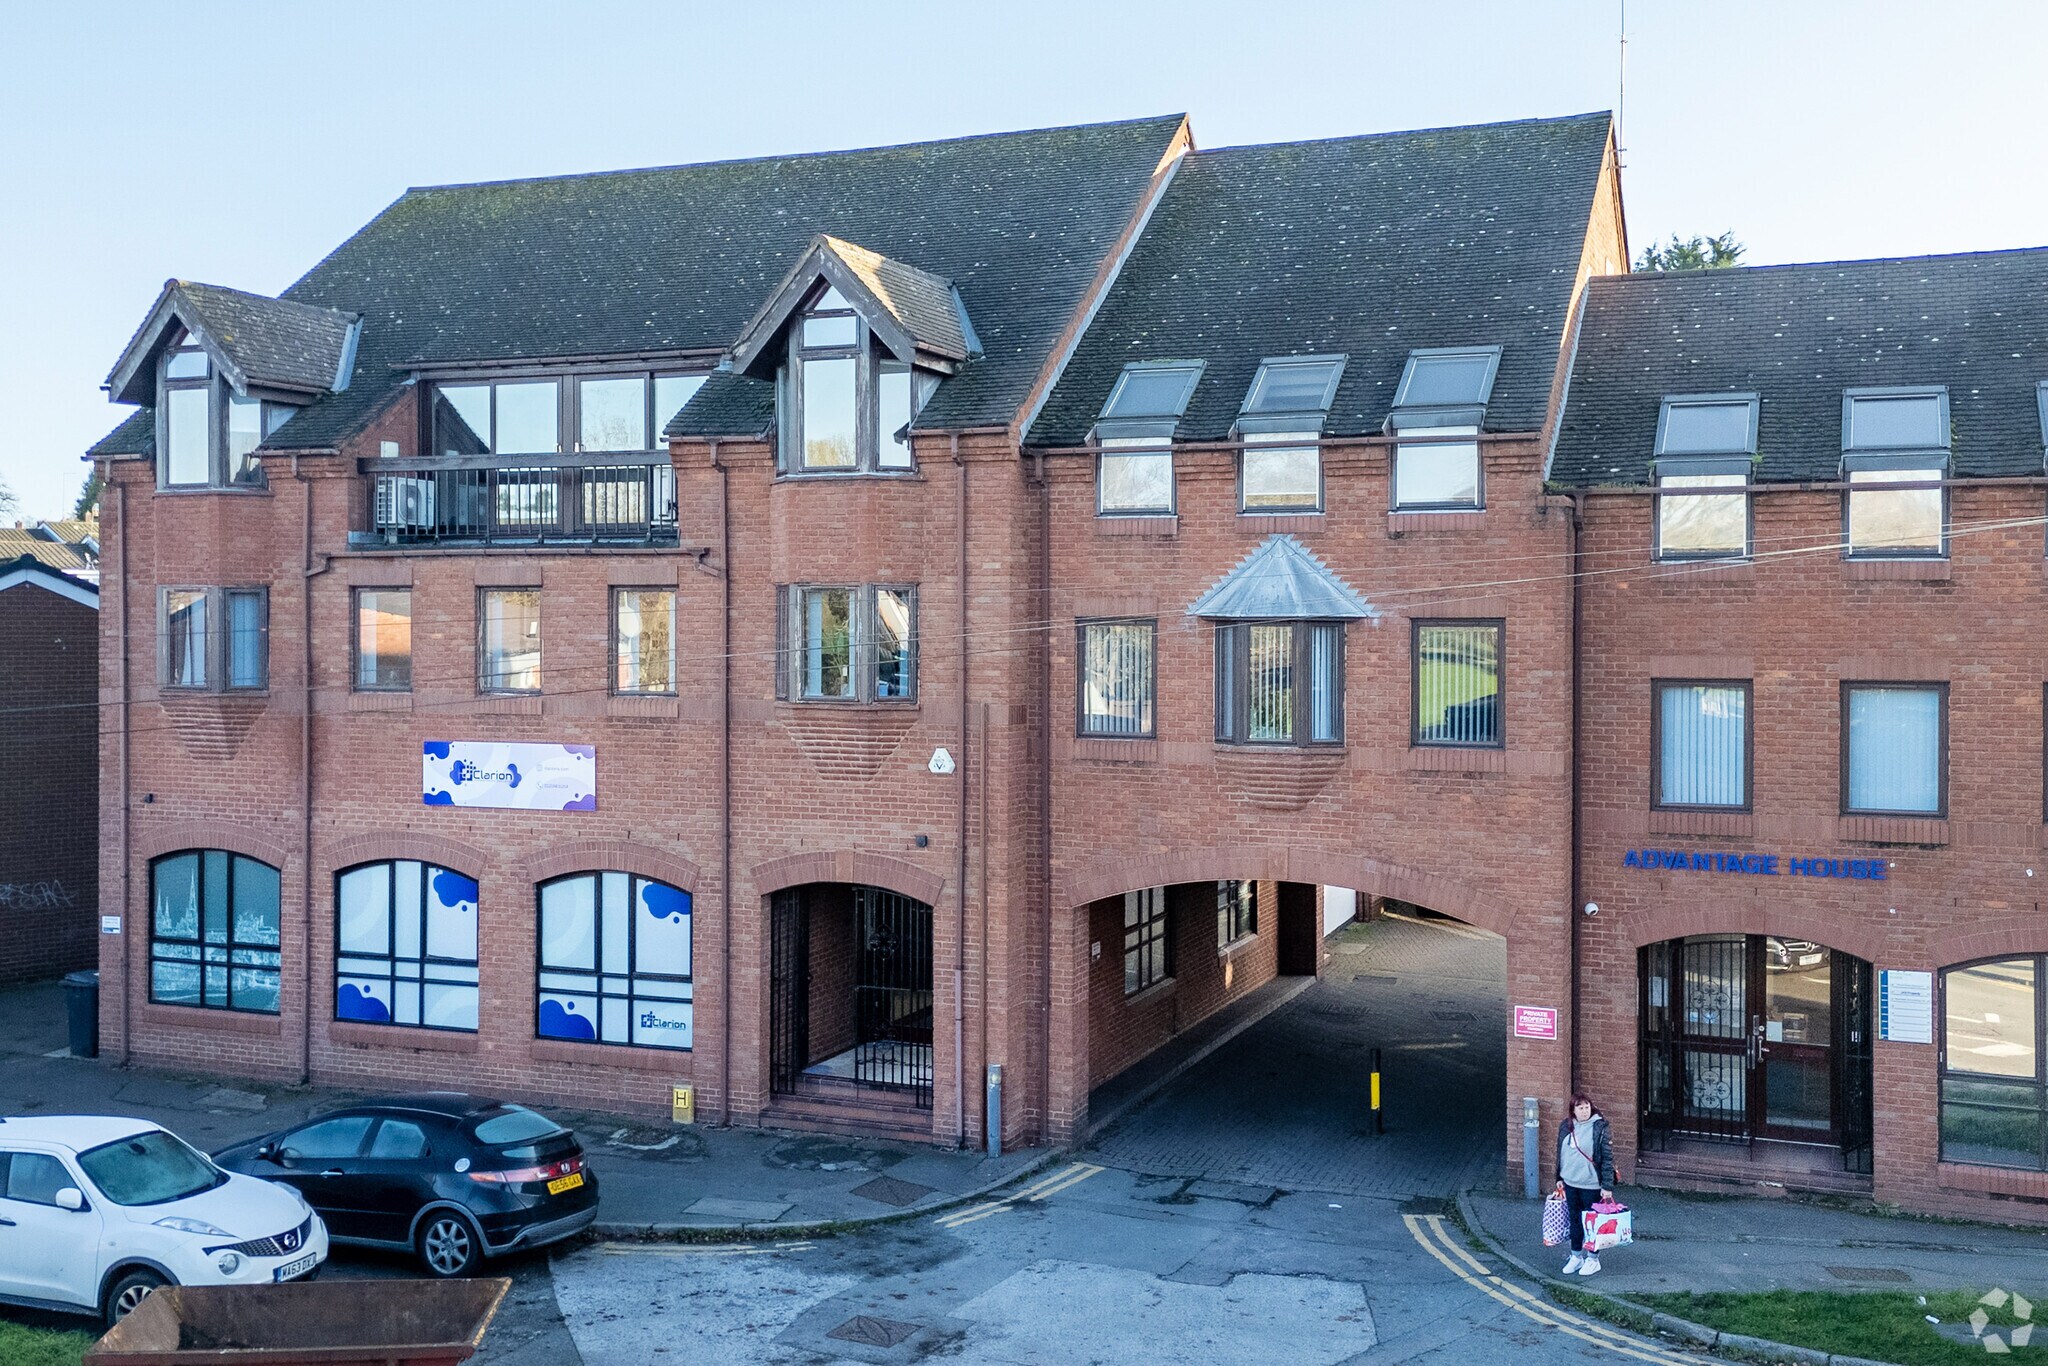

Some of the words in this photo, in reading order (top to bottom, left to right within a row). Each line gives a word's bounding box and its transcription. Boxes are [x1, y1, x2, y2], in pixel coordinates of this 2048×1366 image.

[473, 769, 513, 781] Clarion
[1623, 848, 1778, 876] ADVANTAGE
[1790, 857, 1887, 880] HOUSE
[1523, 1010, 1548, 1018] PRIVATE
[652, 1018, 686, 1029] Clarion
[1519, 1016, 1552, 1025] PROPERTY
[675, 1091, 687, 1106] H
